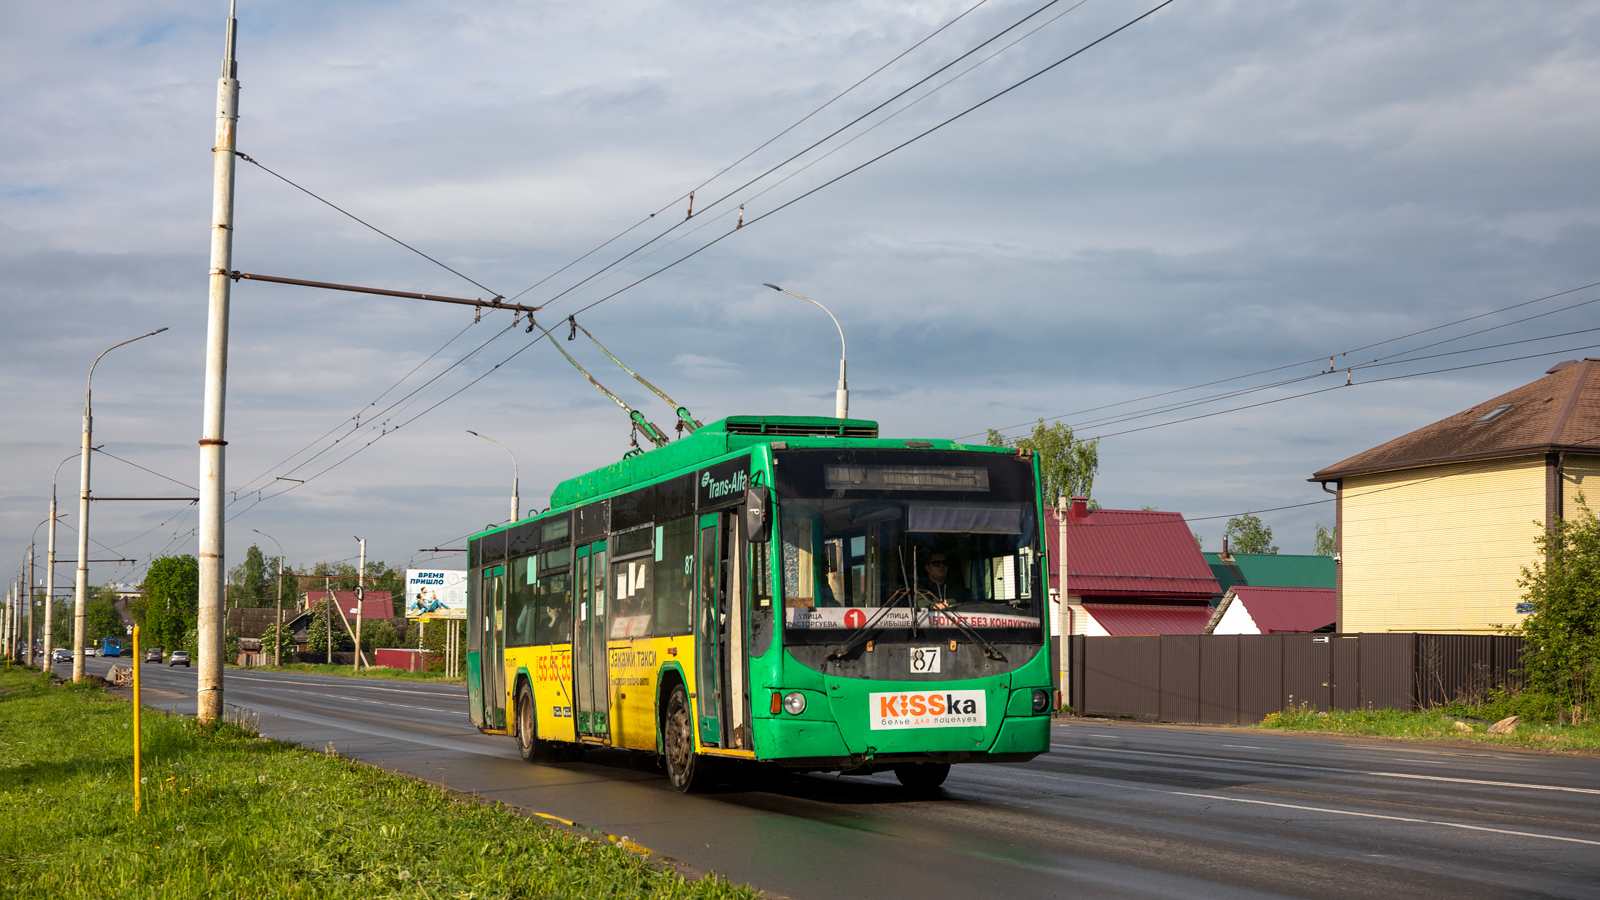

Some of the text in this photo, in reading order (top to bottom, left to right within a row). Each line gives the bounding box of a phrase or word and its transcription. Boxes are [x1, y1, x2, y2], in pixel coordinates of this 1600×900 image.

[709, 470, 747, 499] Trans-Alfa
[684, 555, 693, 575] 87
[849, 611, 859, 629] 1
[885, 612, 910, 620] УЛИЦА
[971, 616, 988, 627] БЕЗ
[610, 651, 657, 668] Закажи такси
[913, 649, 937, 672] 87
[881, 718, 910, 726] белье
[934, 716, 977, 725] поцелуев
